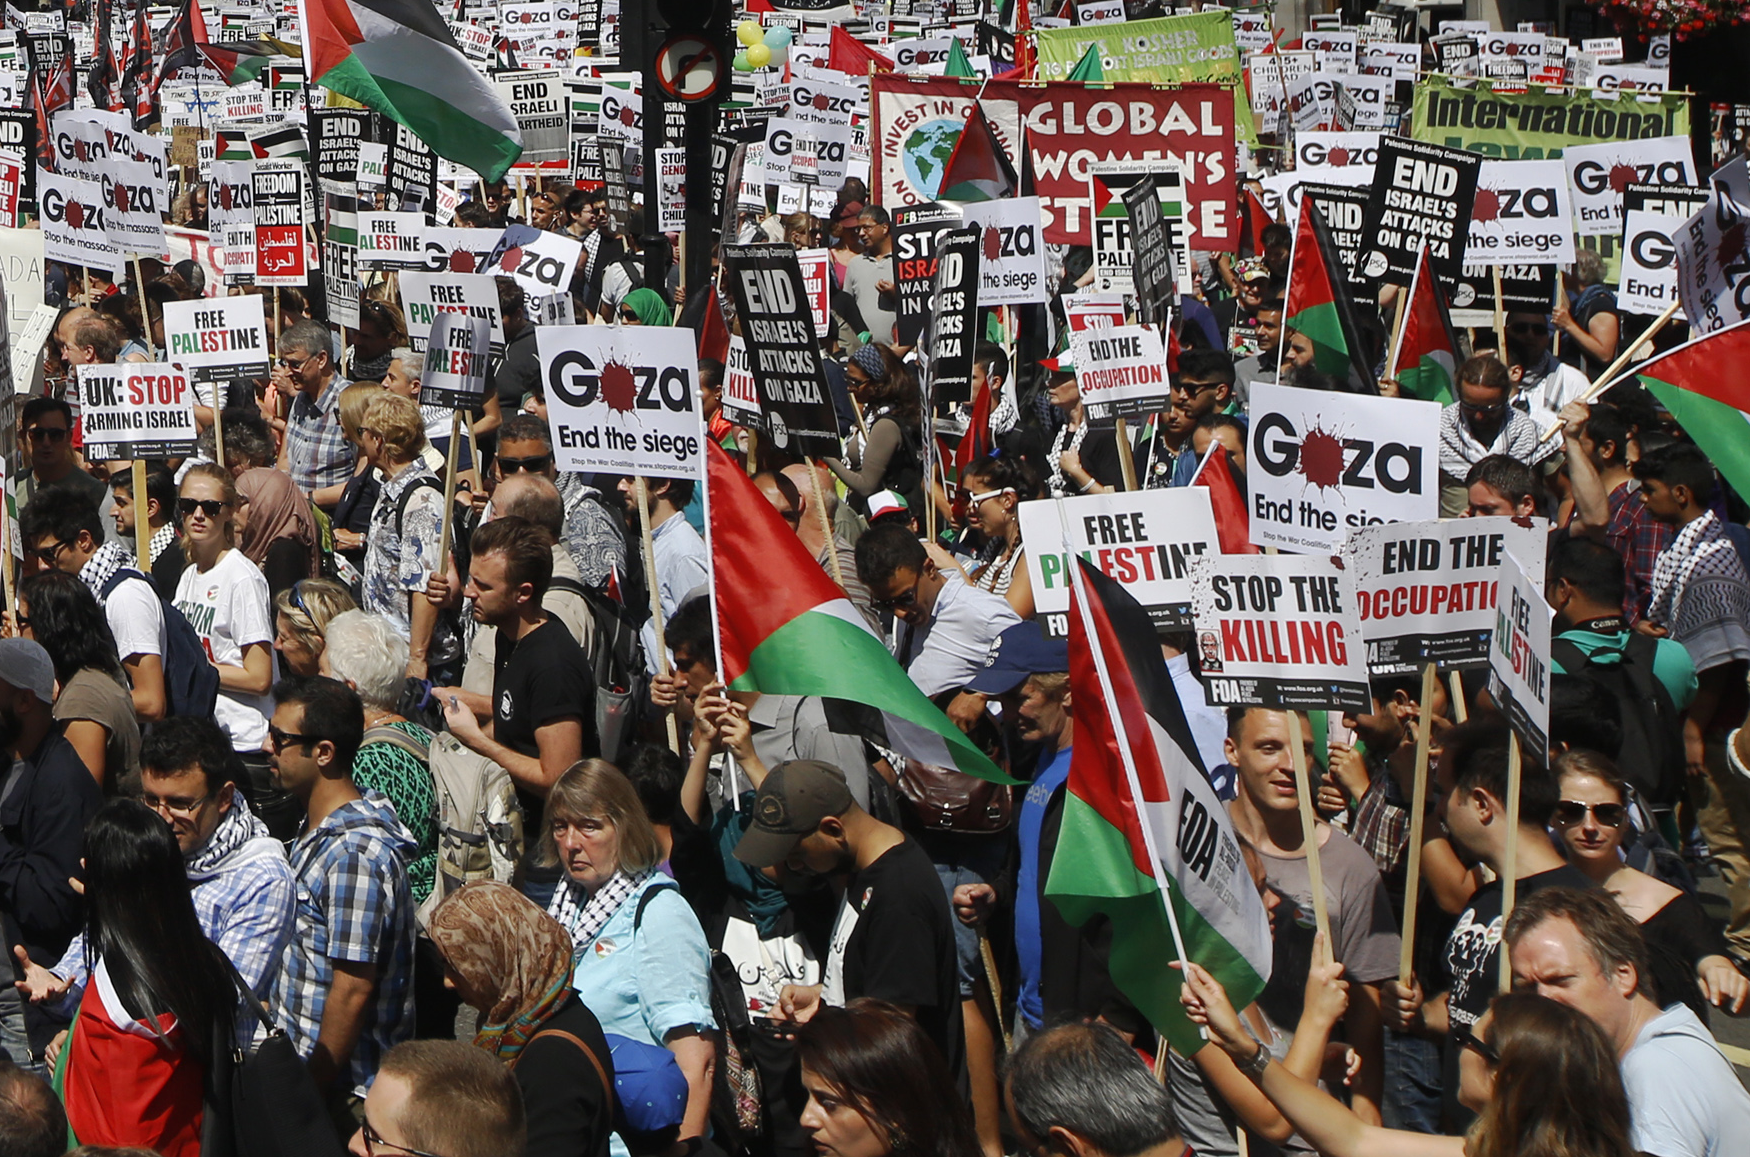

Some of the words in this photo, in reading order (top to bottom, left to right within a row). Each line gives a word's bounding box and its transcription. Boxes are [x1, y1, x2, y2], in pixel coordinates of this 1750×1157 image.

[505, 11, 551, 25] Gza
[1488, 39, 1541, 56] Gza
[512, 83, 548, 99] END
[227, 103, 265, 117] KILLING
[934, 101, 954, 116] IN
[1028, 101, 1224, 136] GLOBAL
[1426, 89, 1674, 140] International
[393, 149, 432, 171] ISRAEL'S
[1118, 164, 1146, 172] Solidarity
[1148, 163, 1179, 172] Campaign
[254, 173, 297, 195] FREEDOM
[254, 204, 301, 226] PALESTINE
[1384, 189, 1458, 219] ISRAEL'S
[1579, 205, 1609, 223] End
[897, 210, 917, 223] PFB
[1380, 211, 1454, 239] ATTACKS
[126, 222, 160, 236] massacre
[1377, 228, 1406, 247] ON
[43, 229, 61, 242] Stop
[77, 239, 119, 255] massacre
[1504, 233, 1562, 252] siege
[898, 281, 924, 296] WAR
[983, 272, 1001, 289] the
[1002, 271, 1038, 290] siege
[1625, 279, 1666, 301] End
[430, 285, 465, 303] FREE
[193, 309, 226, 330] FREE
[171, 326, 261, 356] PALESTINE
[748, 320, 808, 344] ISRAEL'S
[1088, 341, 1108, 361] END
[1114, 336, 1142, 358] THE
[759, 349, 815, 374] ATTACKS
[1082, 364, 1162, 391] OCCUPATION
[766, 377, 783, 402] ON
[783, 379, 823, 405] GAZA
[86, 412, 143, 431] ARMING
[146, 410, 191, 429] ISRAEL
[1087, 404, 1105, 420] FOA
[88, 444, 109, 460] FOA
[559, 425, 600, 449] End
[604, 427, 637, 451] the
[643, 430, 698, 461] siege
[571, 457, 587, 466] Stop
[1254, 492, 1293, 524] End
[1297, 500, 1337, 532] the
[1382, 538, 1442, 576] END
[1451, 532, 1504, 572] THE
[1288, 575, 1343, 615] THE
[1590, 619, 1622, 631] Canon
[1220, 619, 1349, 667] KILLING
[1210, 680, 1241, 703] FOA
[1180, 786, 1218, 883] FOA
